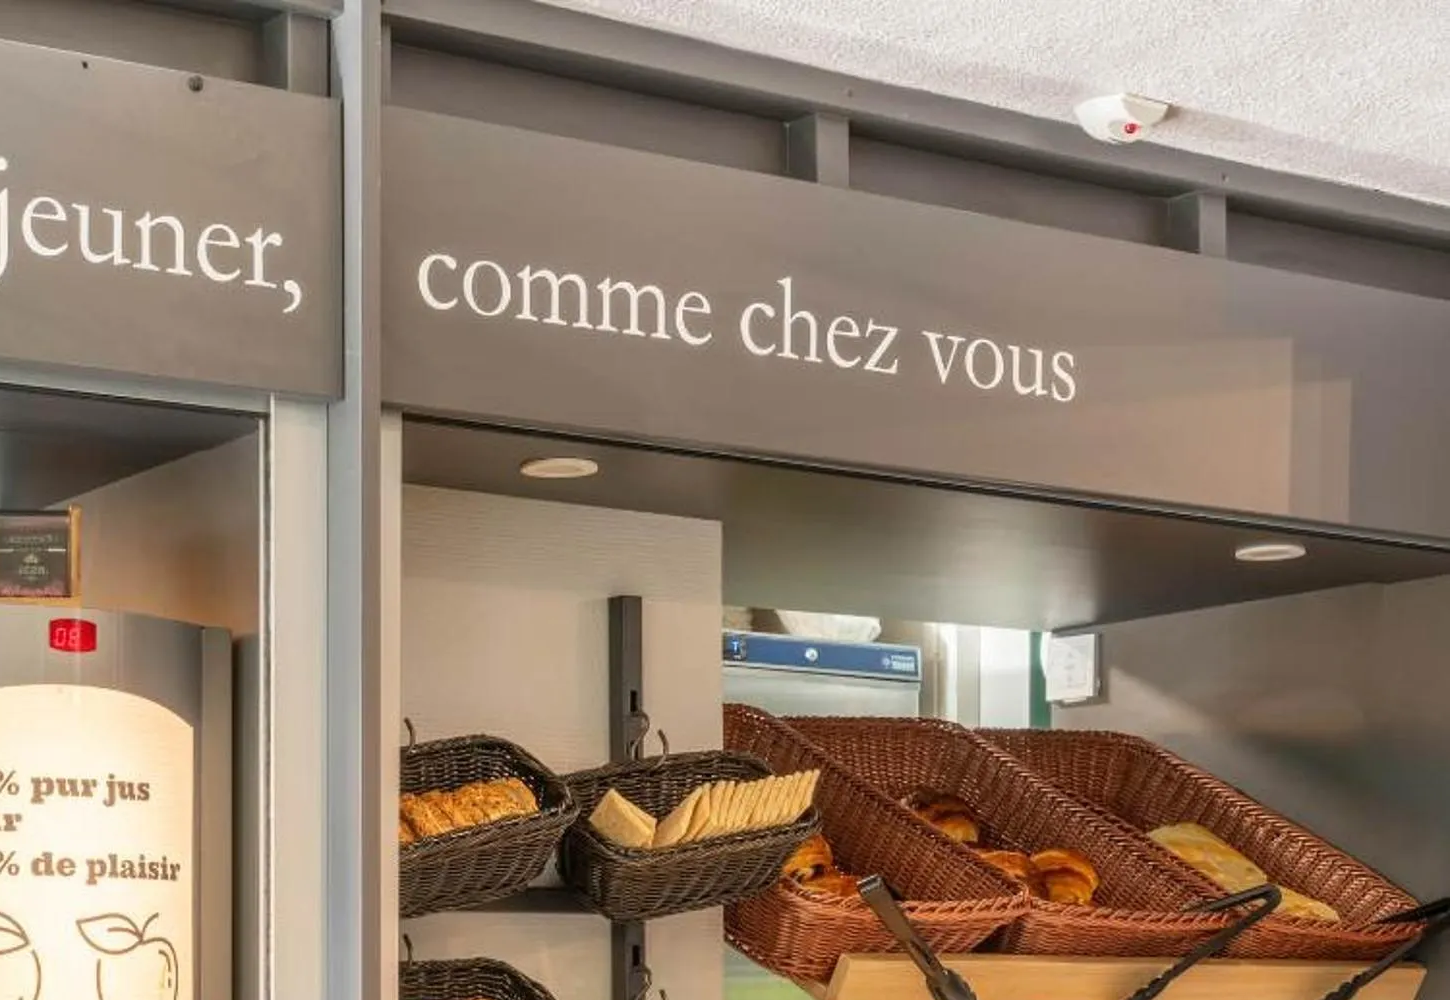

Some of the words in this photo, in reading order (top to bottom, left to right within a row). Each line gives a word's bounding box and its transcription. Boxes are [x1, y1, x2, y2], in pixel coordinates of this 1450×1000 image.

[417, 253, 713, 346] comme
[739, 276, 900, 375] chez
[921, 330, 1077, 402] vous
[30, 775, 98, 804] pur
[102, 773, 150, 807] jus
[30, 851, 77, 877] de
[86, 853, 181, 886] plaisir
